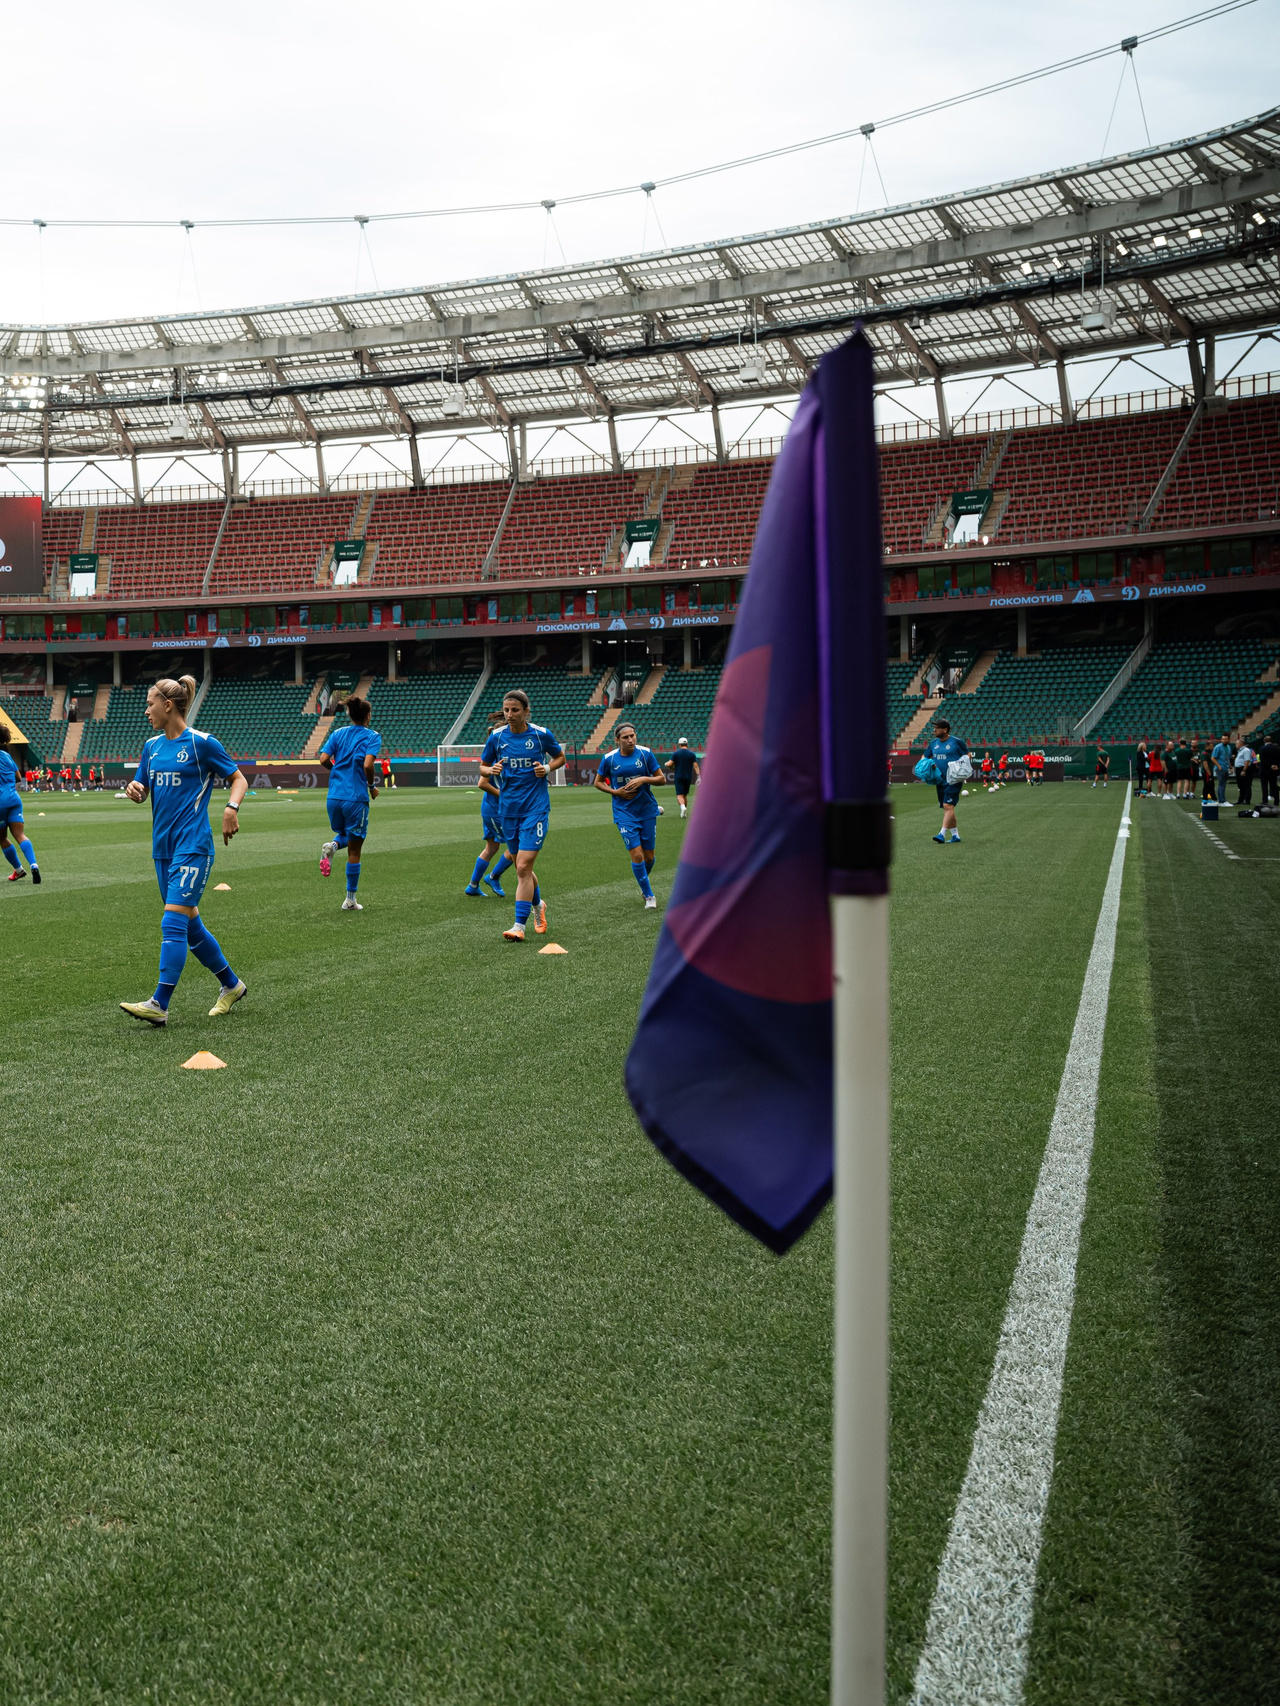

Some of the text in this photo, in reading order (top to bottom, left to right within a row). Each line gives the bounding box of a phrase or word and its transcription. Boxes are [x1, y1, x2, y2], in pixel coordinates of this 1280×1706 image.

[989, 583, 1207, 607] ЛОКОМОТИВ ДИНАМО
[536, 616, 720, 632] ЛОКОМОТИВ ДИНАМО
[152, 636, 307, 648] ЛОКОМОТИВ ДИНАМО
[510, 758, 532, 768] ВТБ
[156, 772, 182, 787] ВТБ
[536, 821, 544, 838] 8
[179, 866, 200, 889] 77
